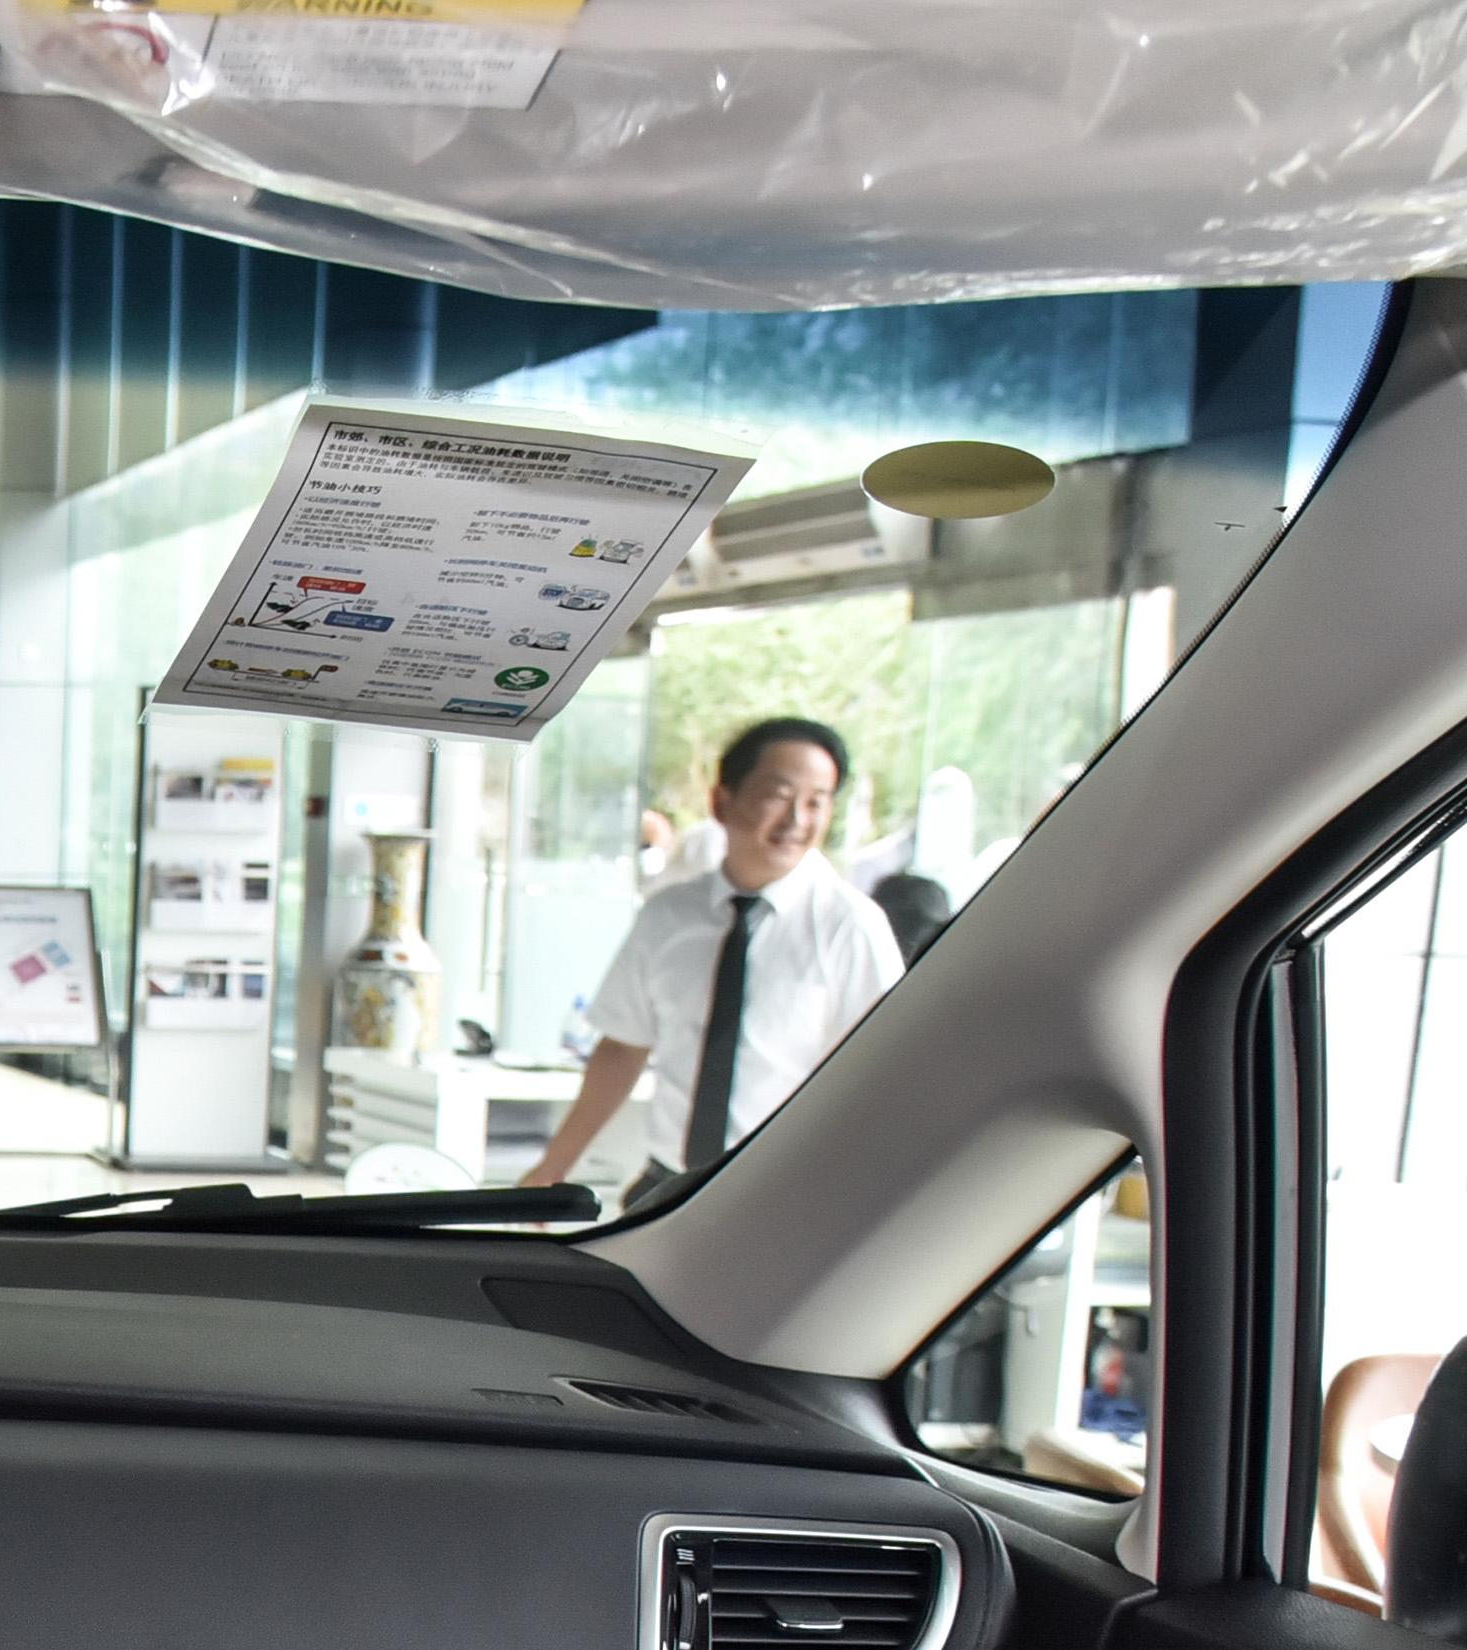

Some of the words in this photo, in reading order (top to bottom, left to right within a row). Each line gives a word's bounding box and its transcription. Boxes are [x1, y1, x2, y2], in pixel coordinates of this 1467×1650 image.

[309, 479, 383, 495] 节油小技巧
